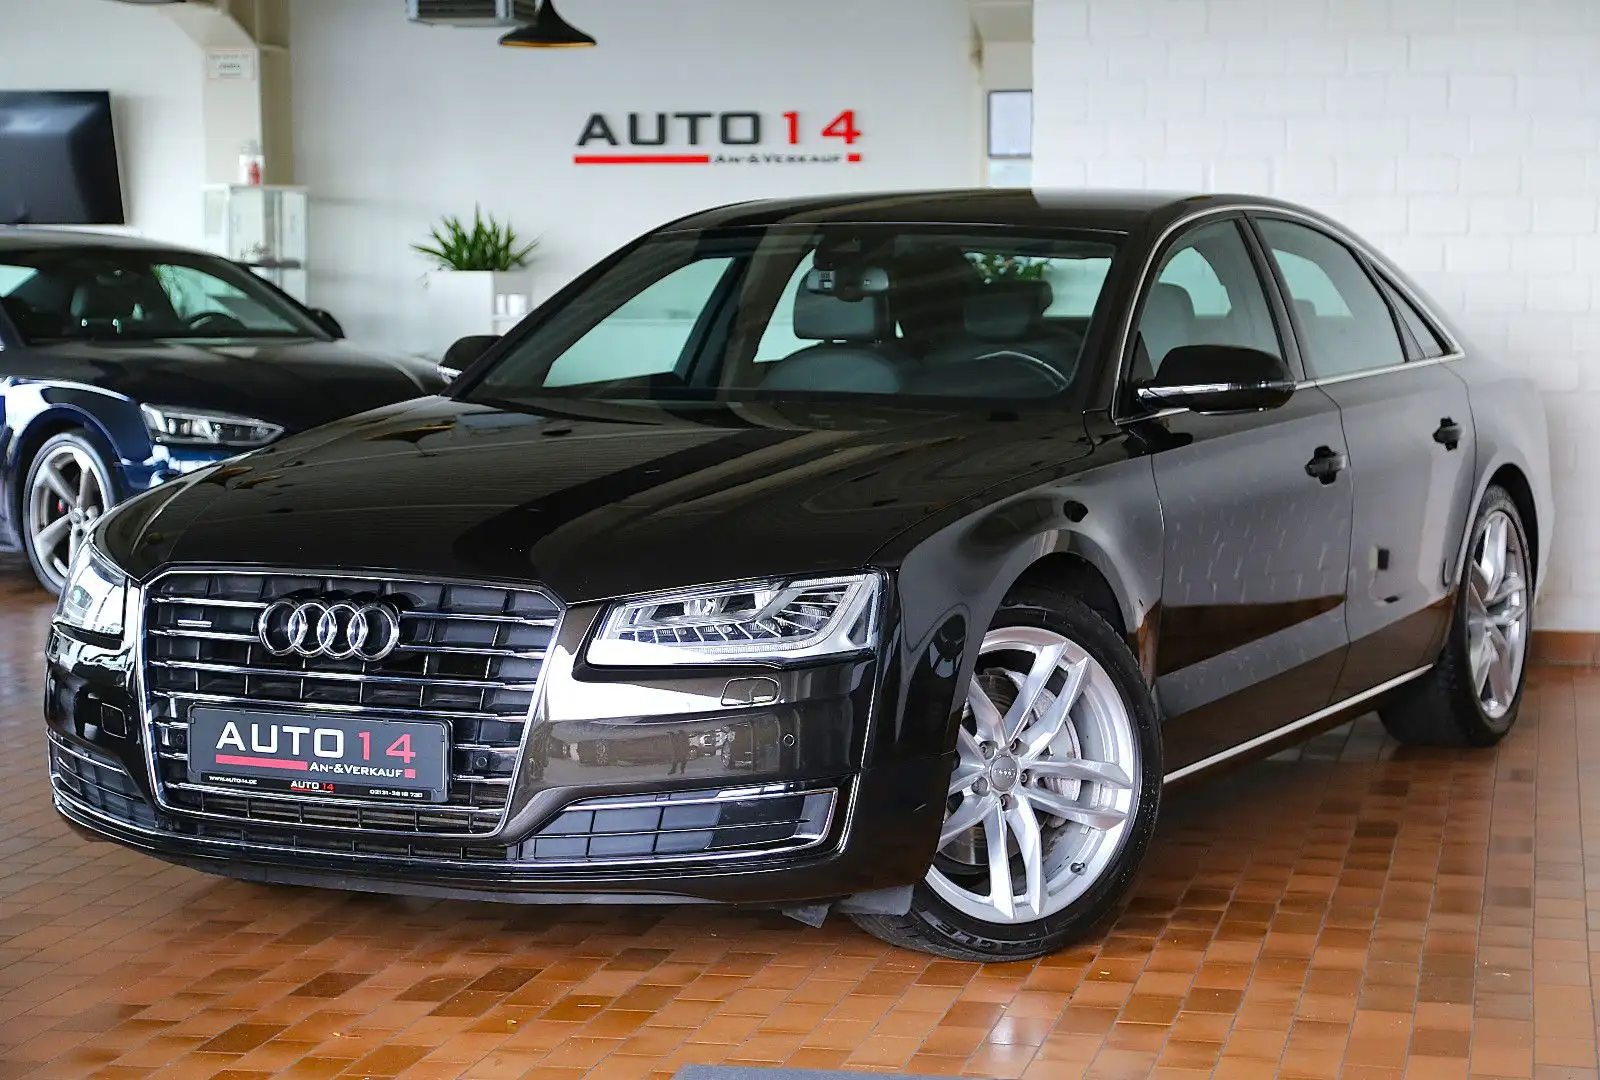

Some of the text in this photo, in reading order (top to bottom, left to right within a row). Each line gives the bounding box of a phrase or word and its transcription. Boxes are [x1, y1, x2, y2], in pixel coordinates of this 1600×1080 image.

[576, 109, 862, 146] AUTO 14
[215, 721, 416, 764] AUTO 14
[290, 780, 335, 791] AUTO 14
